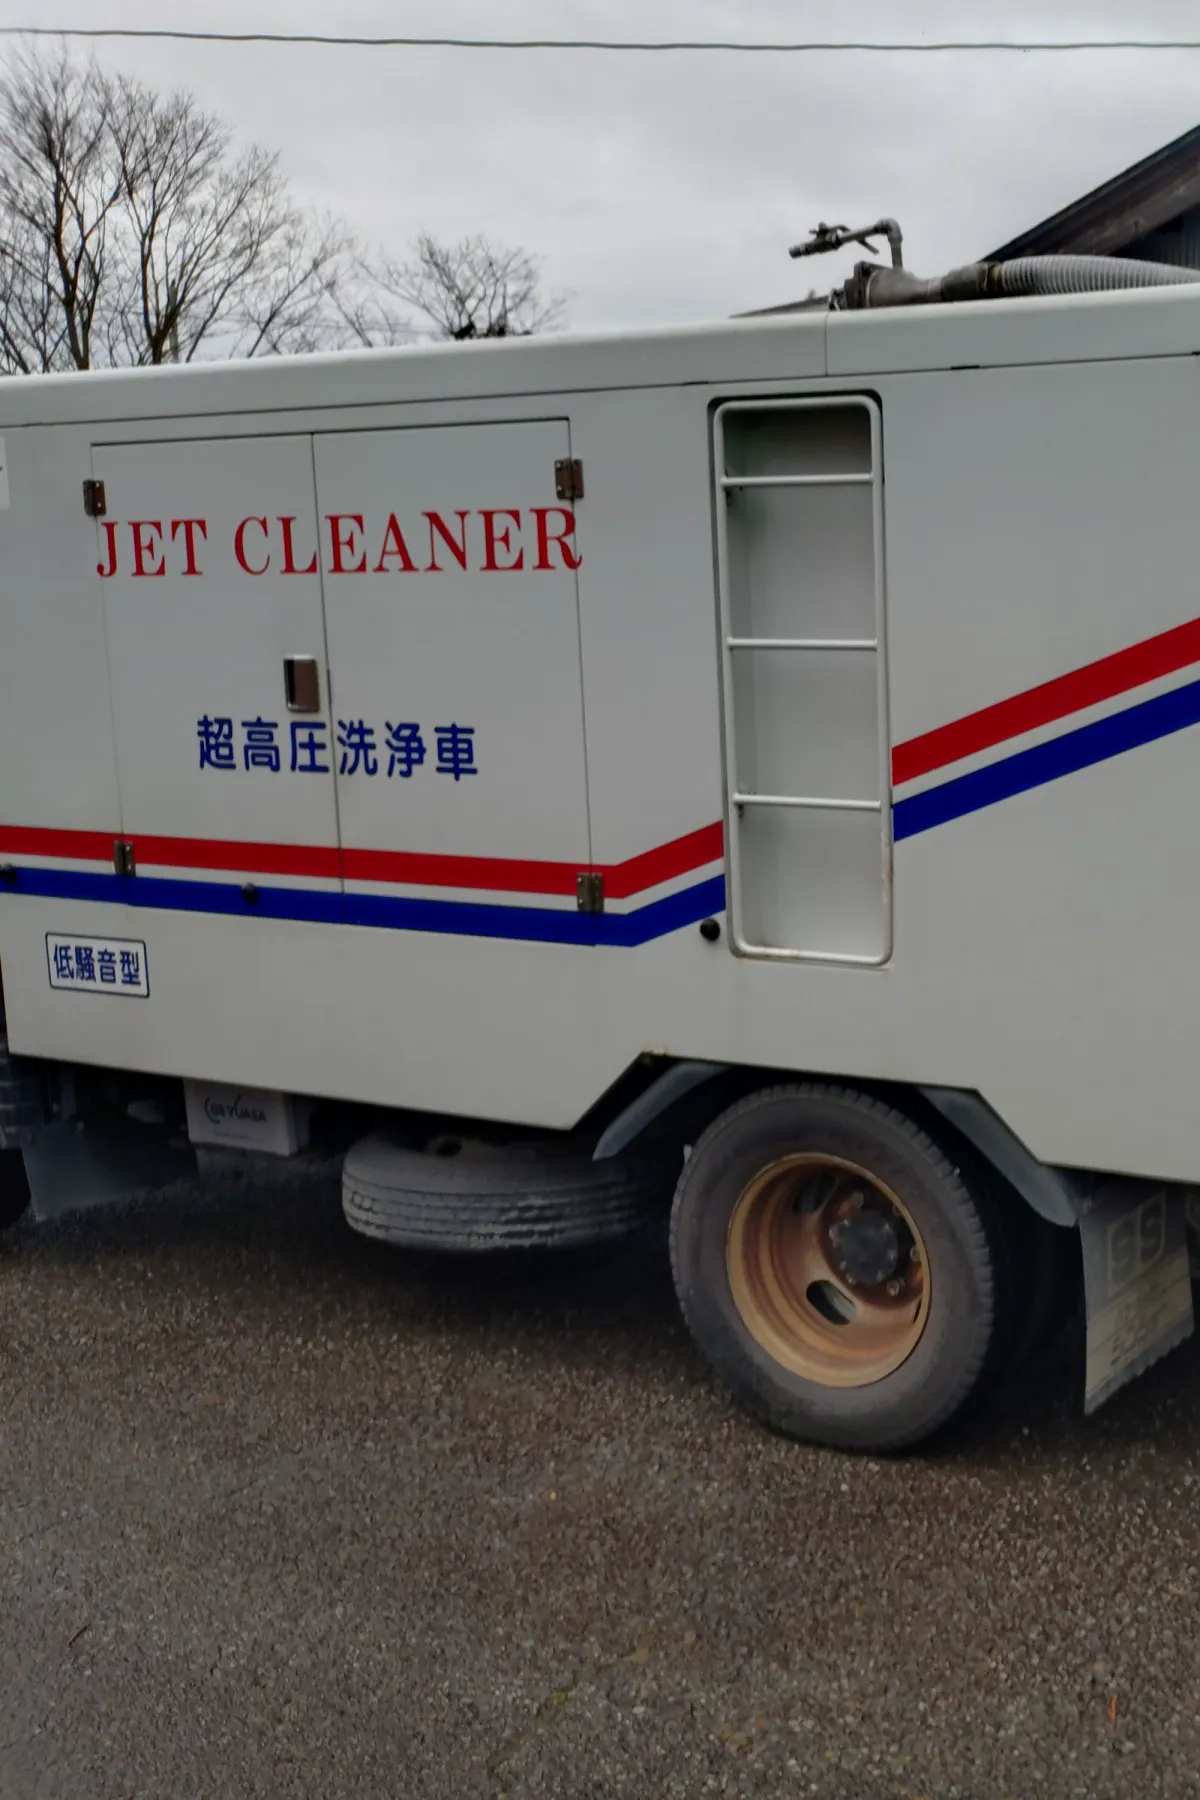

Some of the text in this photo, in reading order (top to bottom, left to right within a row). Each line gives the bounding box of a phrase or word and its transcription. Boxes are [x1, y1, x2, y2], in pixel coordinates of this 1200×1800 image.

[96, 506, 583, 578] JET CLEANER
[197, 715, 478, 781] 超高圧洗浄車
[53, 943, 142, 987] 低騒音型
